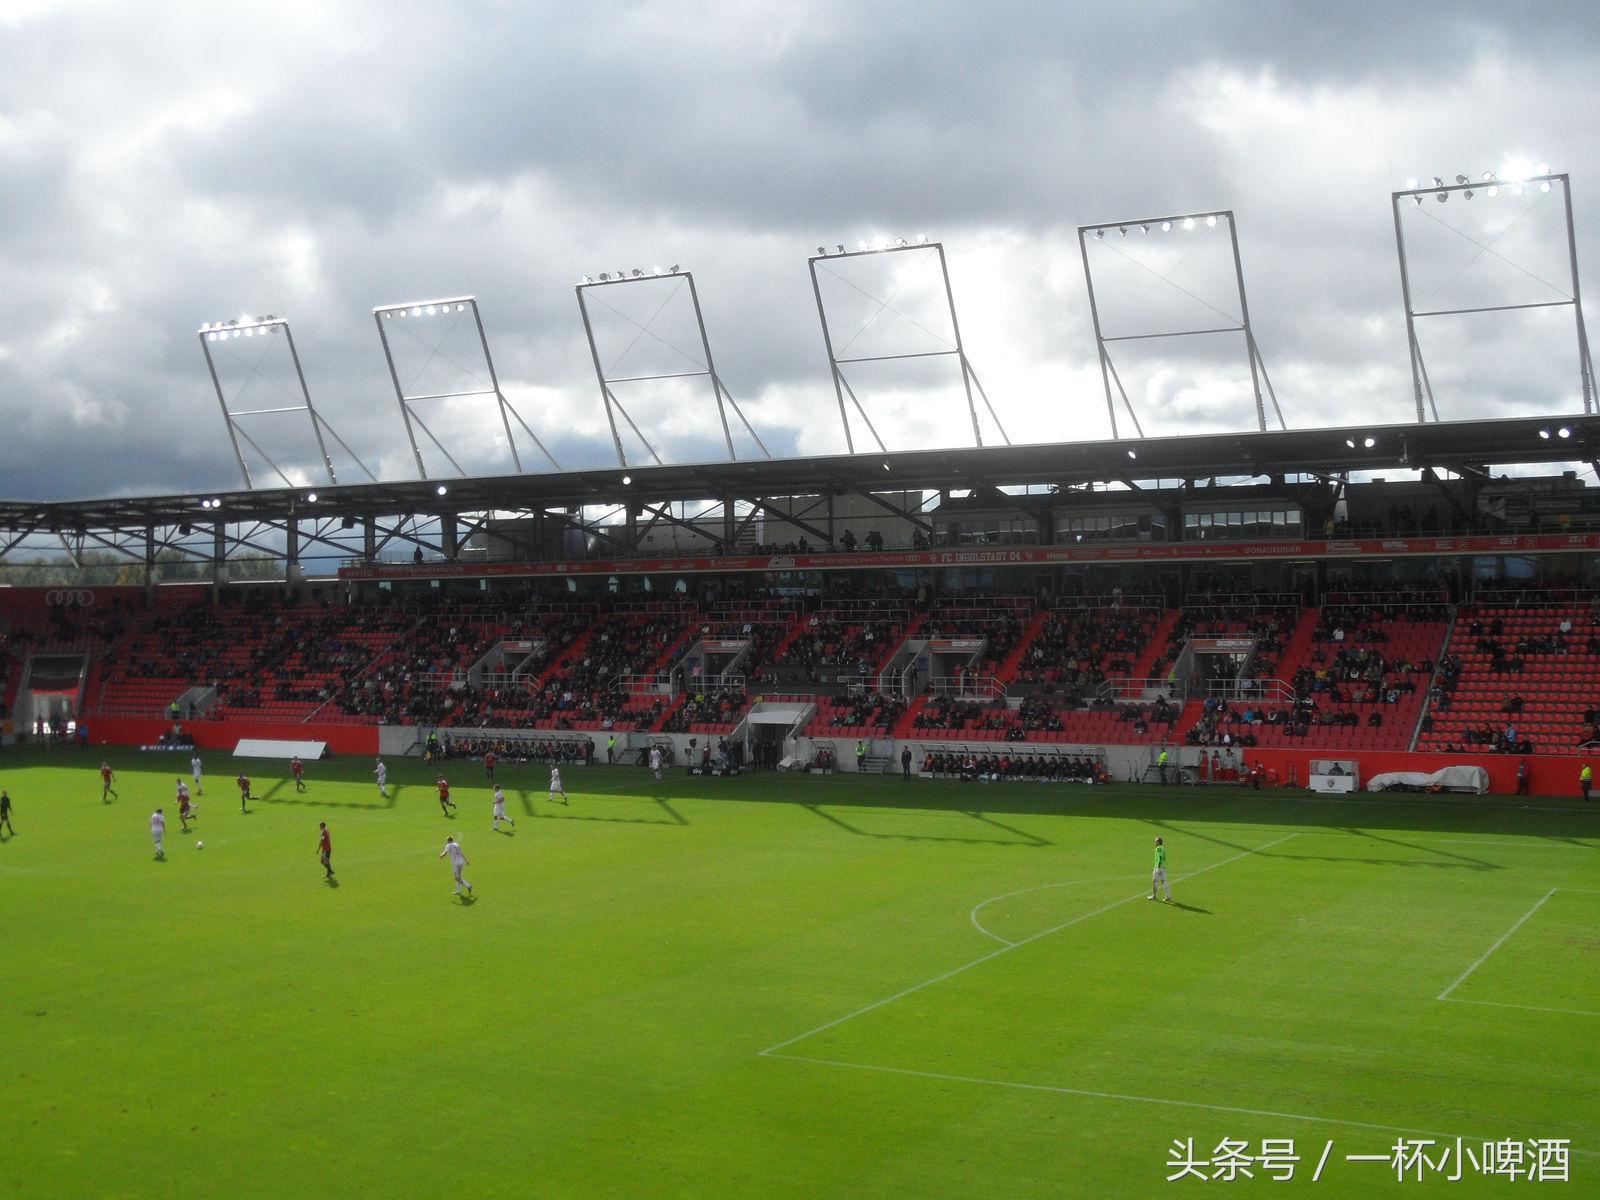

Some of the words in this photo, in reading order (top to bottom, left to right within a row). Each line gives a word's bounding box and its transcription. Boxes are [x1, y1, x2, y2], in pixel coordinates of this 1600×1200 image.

[1245, 545, 1302, 554] DONAUKURIER
[942, 553, 952, 563] FC
[955, 552, 1007, 562] INGOLSTADT
[1010, 551, 1021, 561] 04
[712, 768, 722, 776] sky
